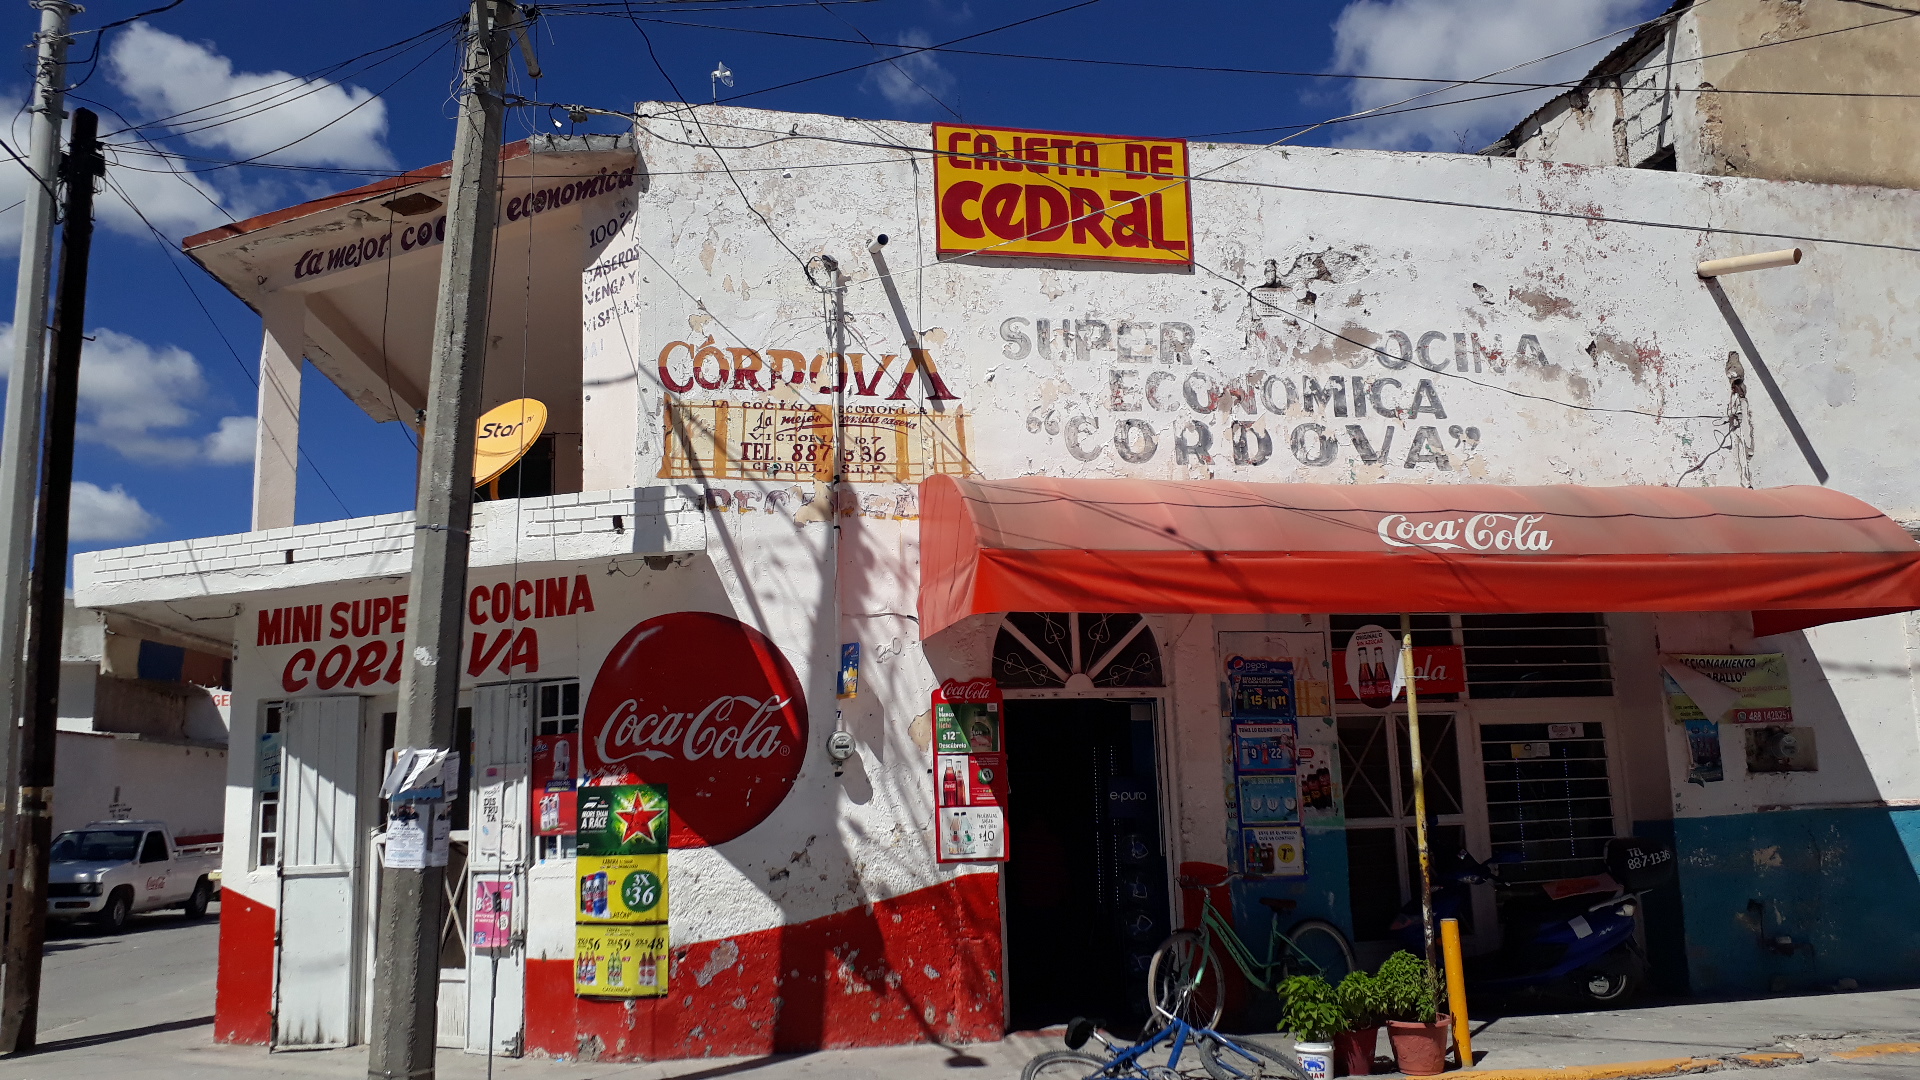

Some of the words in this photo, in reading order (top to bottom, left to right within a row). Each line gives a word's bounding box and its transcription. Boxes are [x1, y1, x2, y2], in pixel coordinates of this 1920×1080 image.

[948, 132, 1100, 178] CAJETA
[1125, 143, 1174, 181] DE
[328, 230, 393, 269] mejor
[506, 165, 636, 222] economica
[999, 316, 1196, 366] SUPER
[1108, 369, 1448, 420] ECONOMICA
[711, 399, 730, 409] LA
[742, 399, 819, 413] COCINA
[753, 411, 774, 432] La
[478, 422, 524, 439] Star
[870, 436, 882, 444] 7
[740, 442, 782, 461] TEL.
[792, 443, 834, 462] 887
[1377, 513, 1554, 551] Coca-Cola
[257, 604, 323, 647] MINI
[329, 594, 409, 640] SUPE
[468, 574, 596, 626] COCINA
[1356, 633, 1378, 641] ORIGINAL
[1245, 661, 1268, 671] pepsi
[1680, 658, 1756, 670] ACCIONAMIENTO
[941, 681, 992, 700] Coca-Cola
[212, 694, 232, 707] GE
[595, 694, 793, 764] Coca-Cola
[581, 810, 596, 818] MORE
[580, 818, 588, 829] A
[588, 817, 608, 830] RACE
[979, 829, 995, 842] $10
[1627, 847, 1643, 857] TEL
[632, 873, 650, 887] 3X
